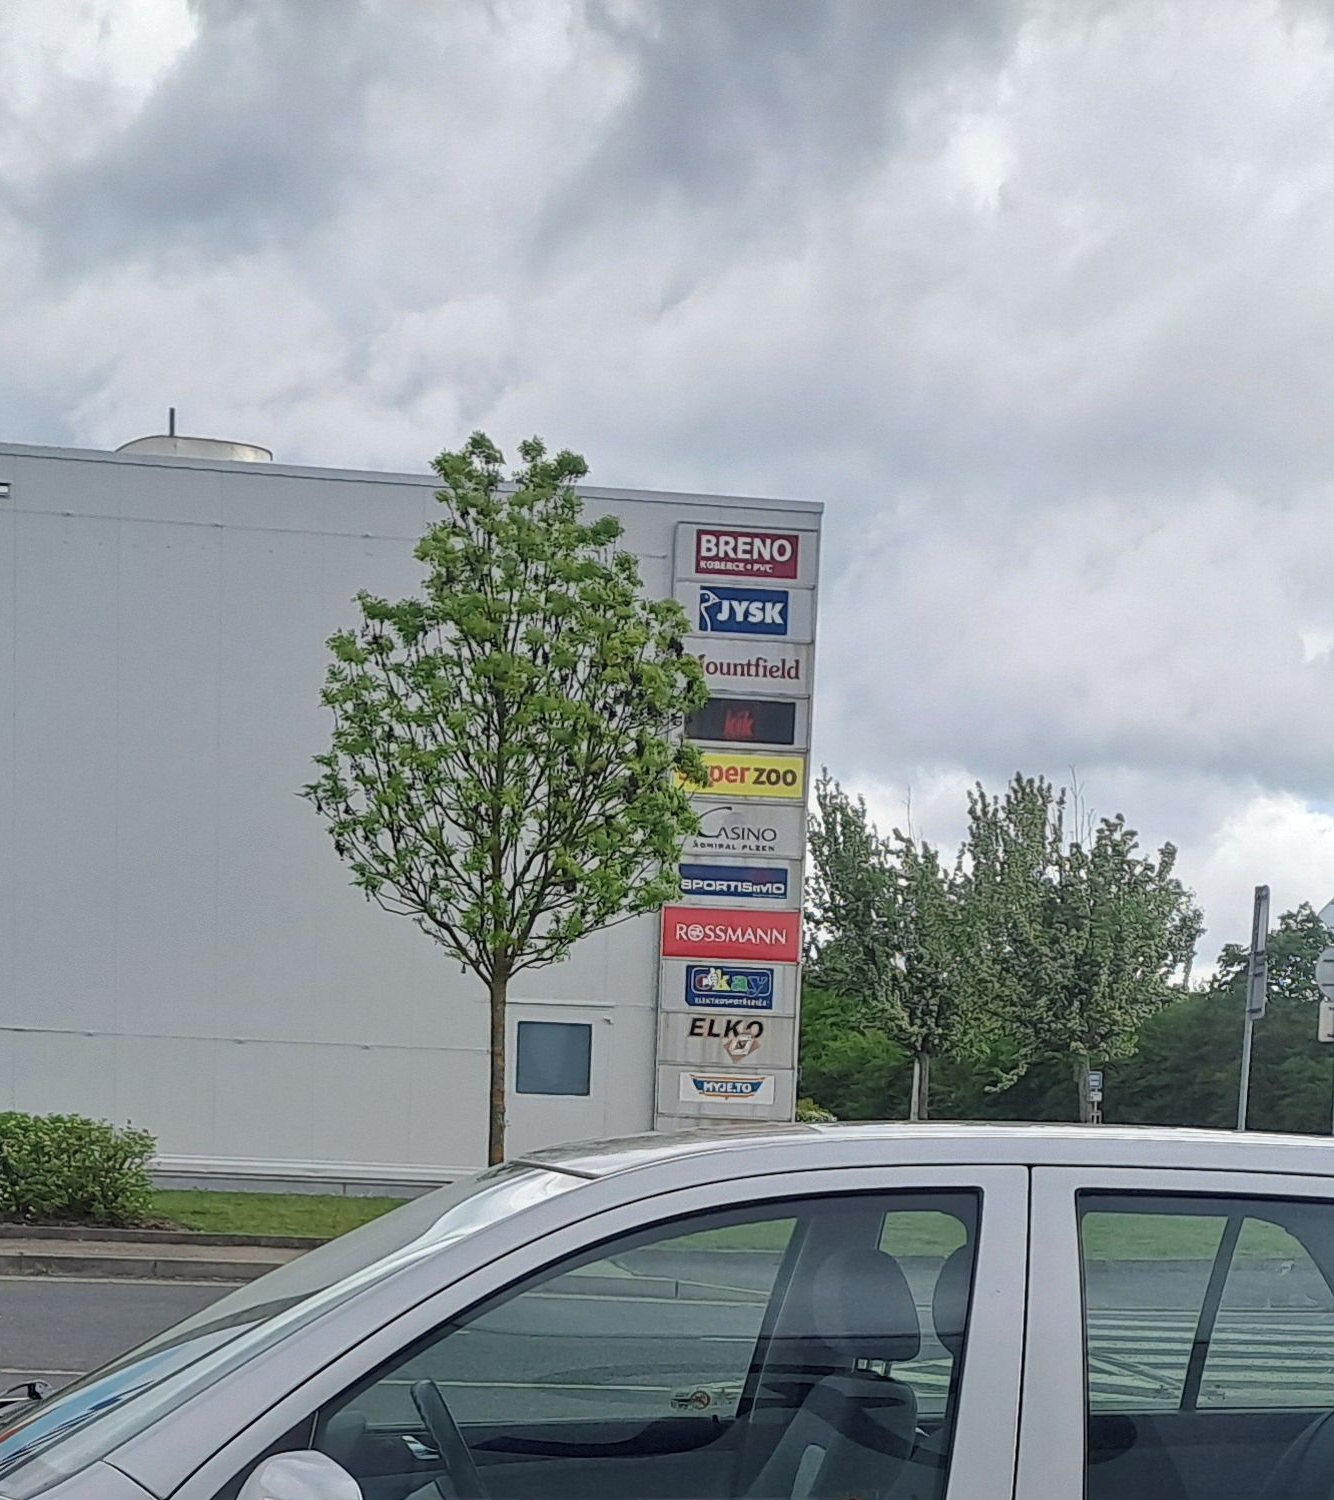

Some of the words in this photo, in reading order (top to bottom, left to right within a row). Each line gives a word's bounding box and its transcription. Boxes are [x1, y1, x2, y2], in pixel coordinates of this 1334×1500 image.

[700, 534, 792, 562] BRENO
[716, 600, 785, 624] JYSK
[699, 654, 800, 680] ountfield
[675, 922, 787, 944] ROSSMANN
[689, 1017, 764, 1038] ELKO
